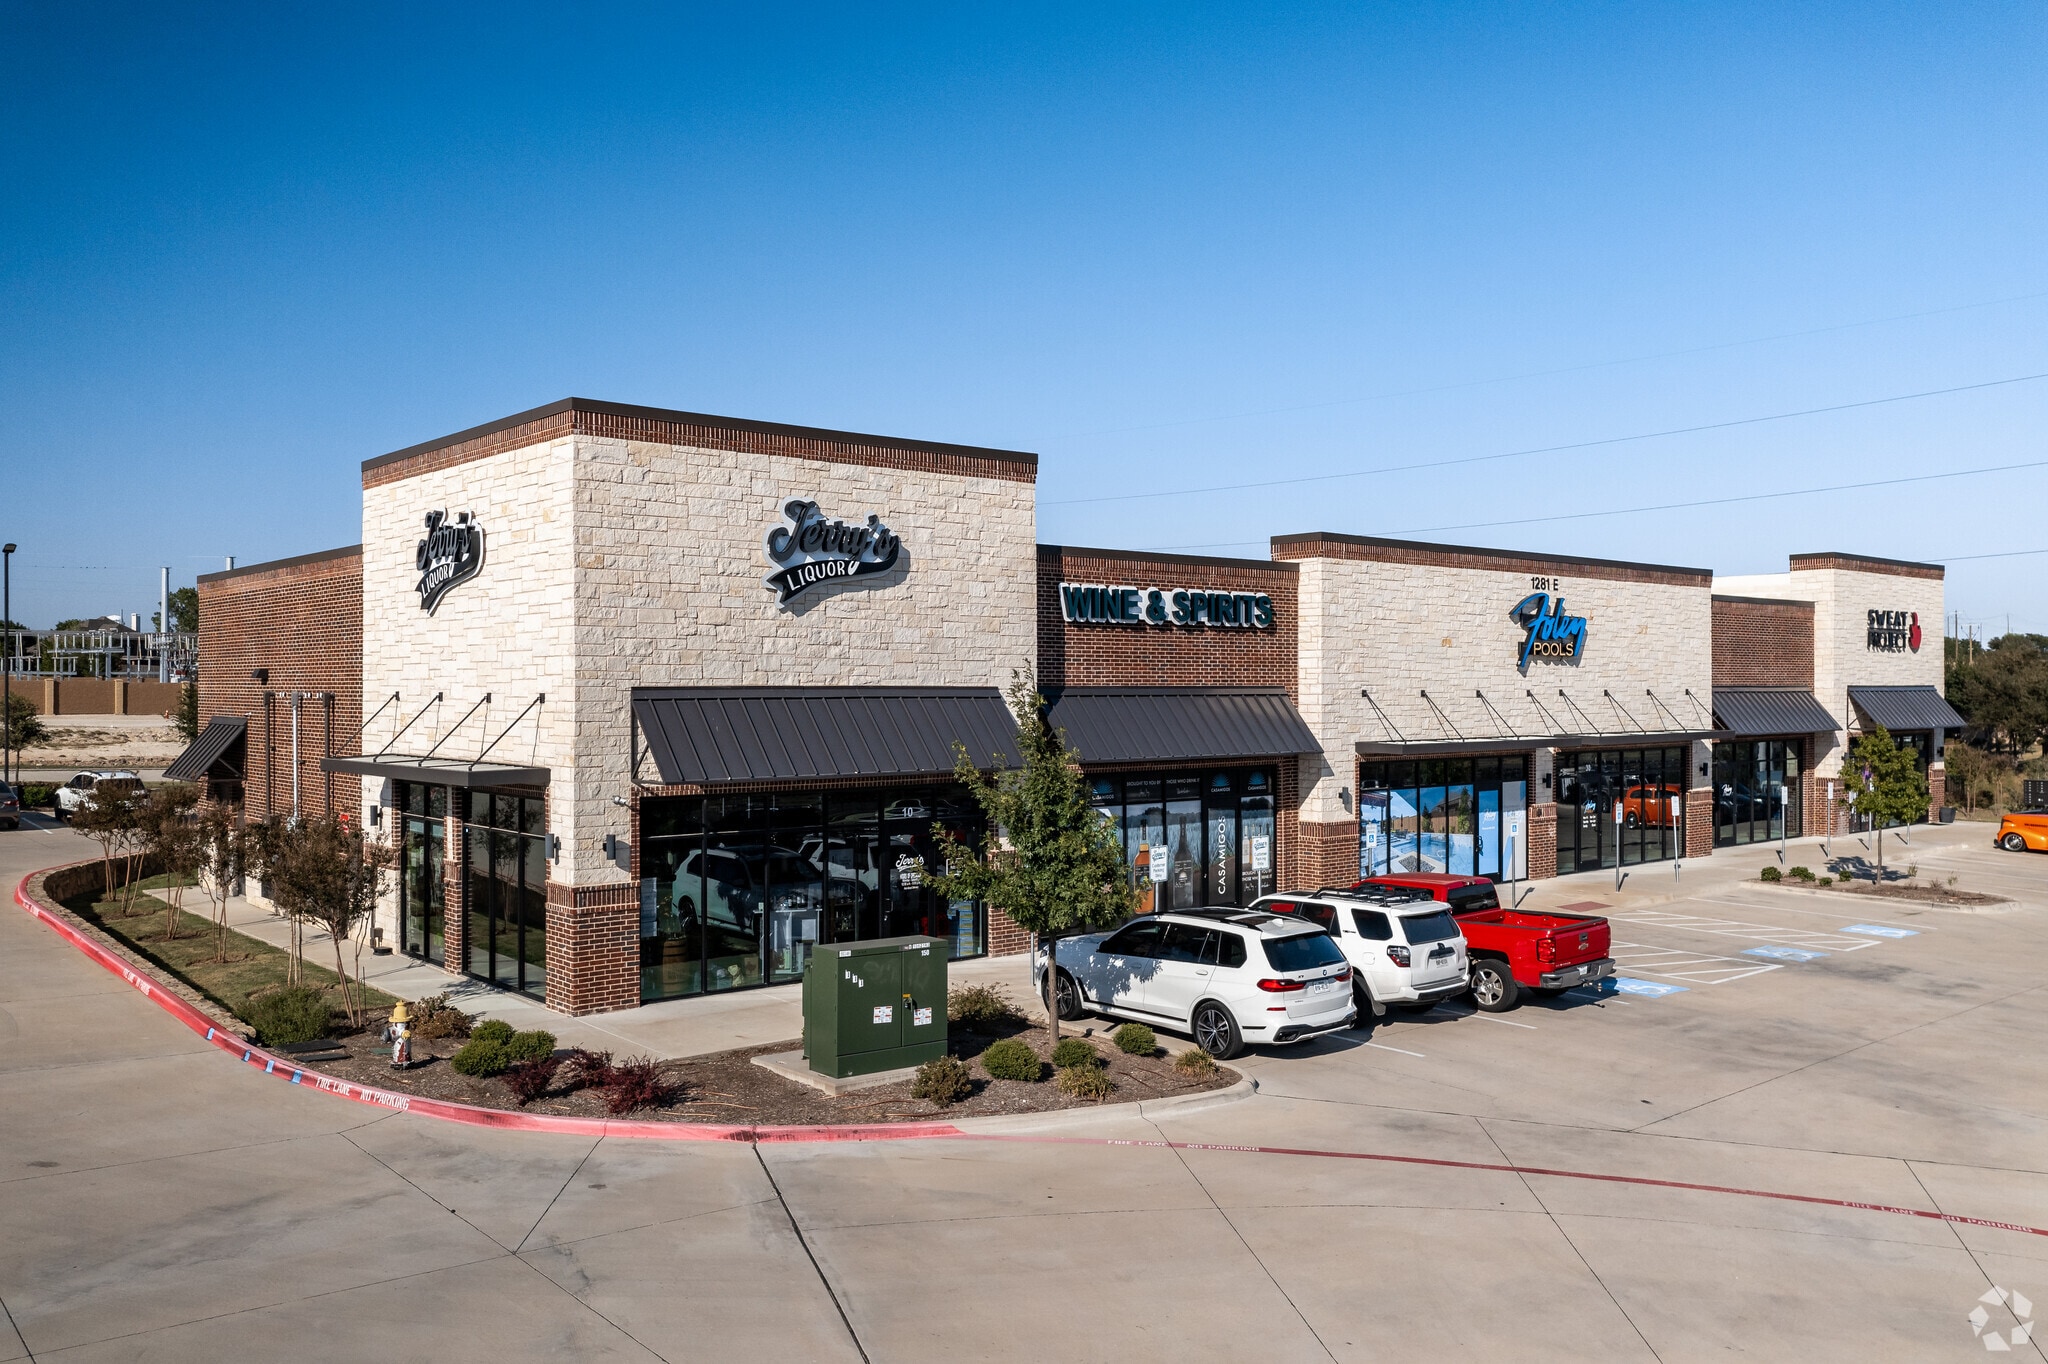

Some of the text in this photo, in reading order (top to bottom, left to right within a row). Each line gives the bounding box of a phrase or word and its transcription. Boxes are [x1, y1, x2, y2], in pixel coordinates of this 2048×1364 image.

[416, 510, 474, 574] Jerry's
[767, 500, 896, 575] Jerry's
[421, 564, 449, 598] LIQUOR
[787, 561, 845, 591] LIQUOR
[1531, 577, 1558, 591] 1281 E
[1060, 583, 1272, 627] WINE & SPIRITS
[1867, 609, 1908, 627] SWEAT
[1508, 592, 1587, 667] Foley
[1867, 631, 1907, 650] PROJECT
[1533, 642, 1574, 656] POOLS
[902, 807, 913, 817] 10
[1218, 816, 1226, 895] CASAMIGOS
[316, 1077, 410, 1111] FIRE LANE NO PARKING
[1843, 1201, 2033, 1232] FIRE LANE NO PARKING
